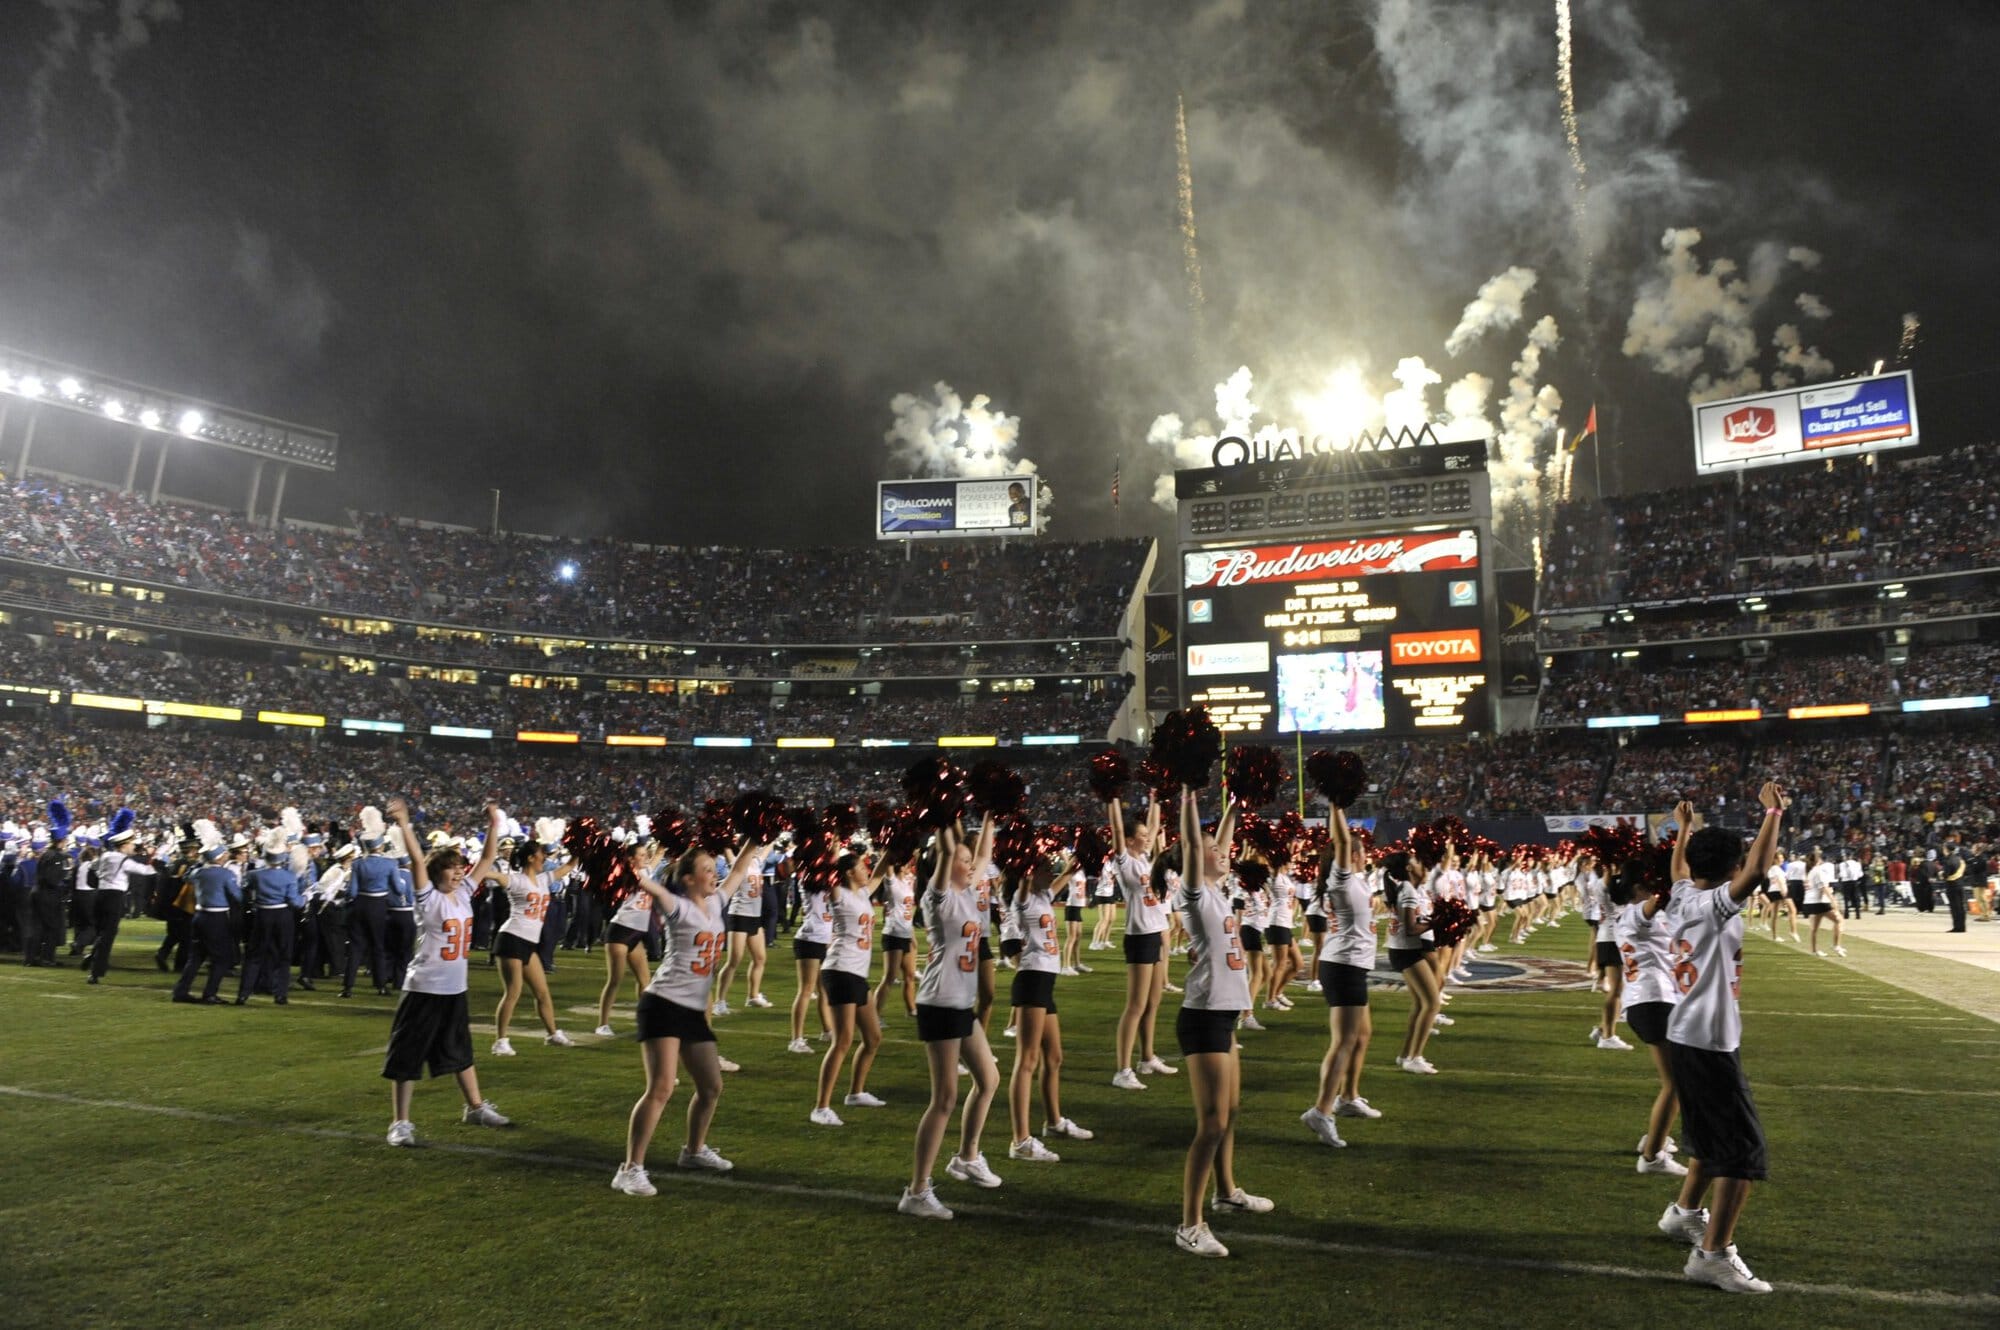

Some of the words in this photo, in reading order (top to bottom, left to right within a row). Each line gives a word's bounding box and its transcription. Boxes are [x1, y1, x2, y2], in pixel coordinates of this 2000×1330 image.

[1820, 408, 1842, 419] Buy
[1843, 403, 1865, 416] and
[1865, 399, 1888, 412] Sell
[1728, 410, 1775, 441] Jack
[1808, 418, 1858, 434] Chargers
[1212, 422, 1440, 468] QUALCOMM
[884, 498, 953, 513] QUALCOMM
[1213, 539, 1403, 587] Budweiser
[1394, 638, 1476, 658] TOYOTA
[1501, 632, 1536, 646] Sprint
[1146, 651, 1176, 664] Sprint
